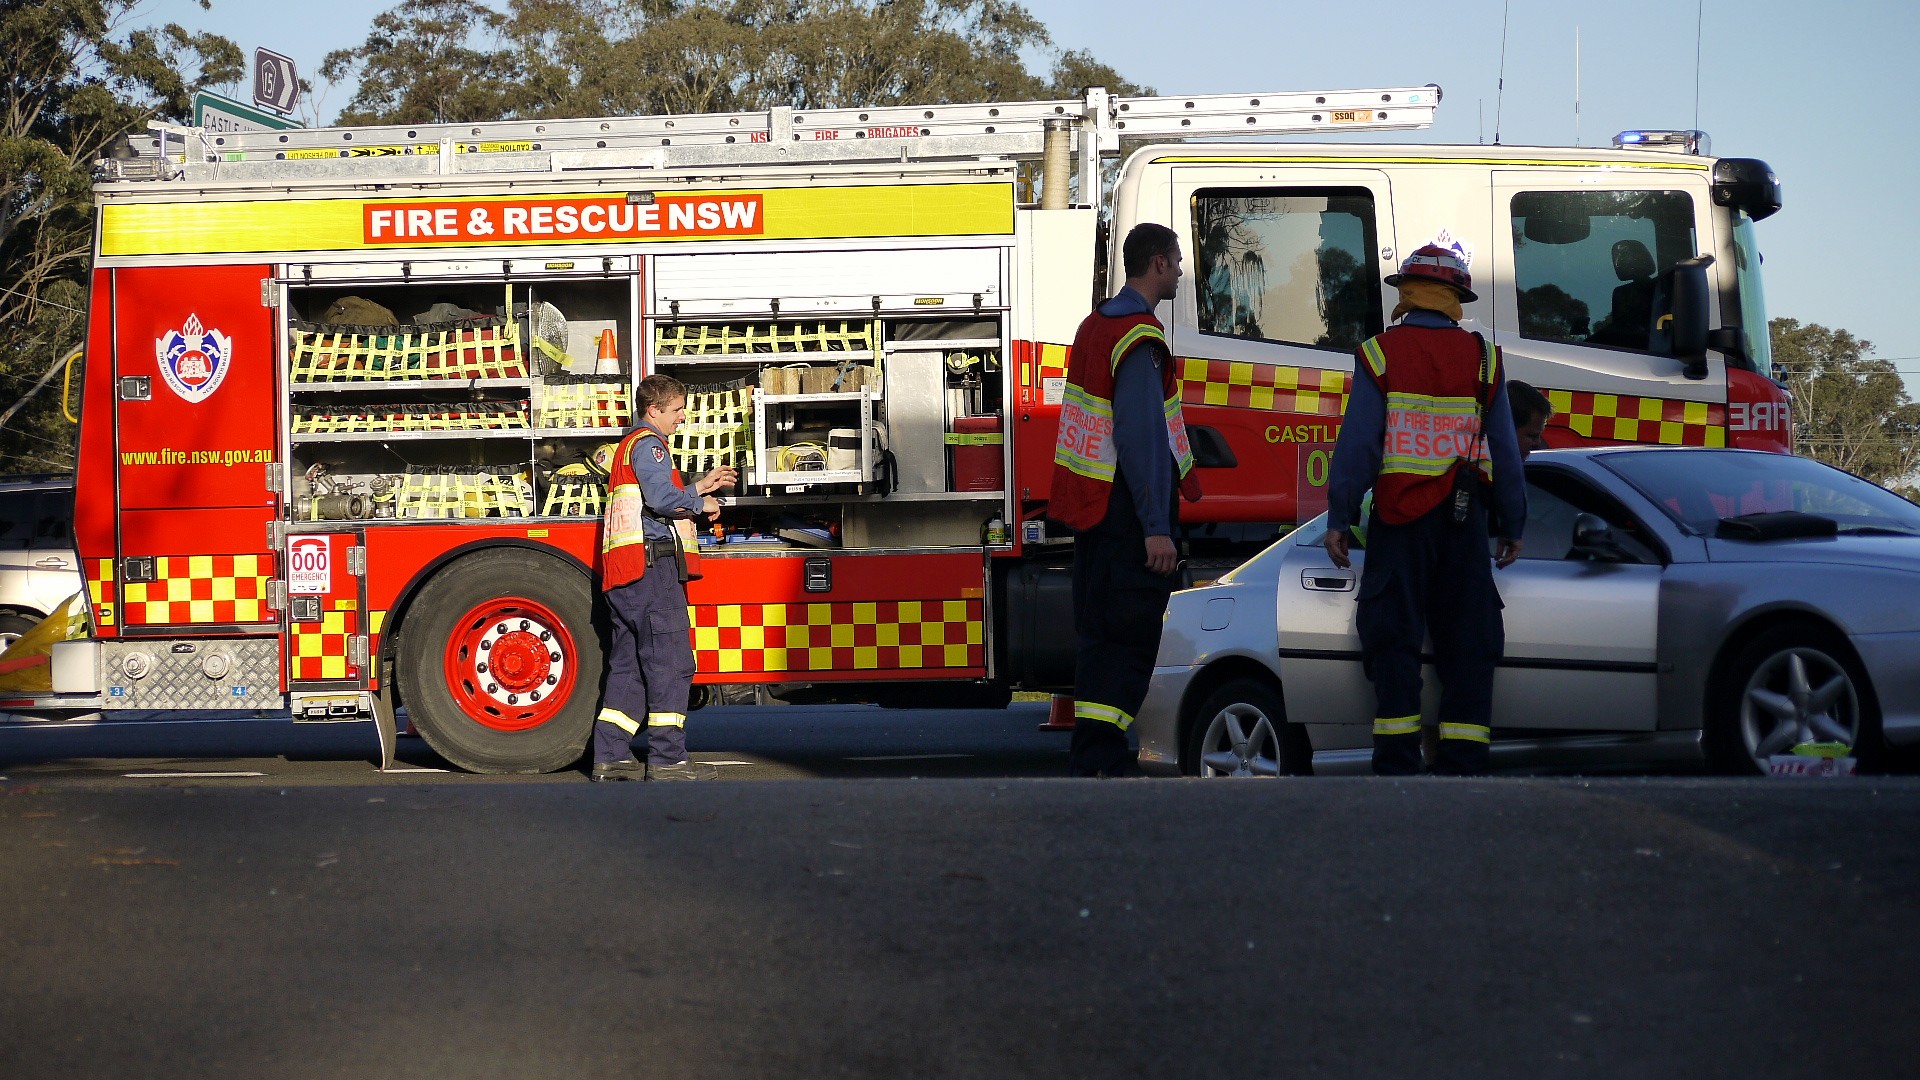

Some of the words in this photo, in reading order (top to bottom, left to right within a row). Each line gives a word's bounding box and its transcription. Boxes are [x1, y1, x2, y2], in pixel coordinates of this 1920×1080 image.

[264, 71, 273, 94] 15
[815, 130, 839, 141] FIRE
[867, 126, 919, 138] BRIGADES
[370, 208, 459, 238] FIRE
[466, 207, 495, 235] &
[504, 203, 661, 235] RESCUE
[668, 201, 758, 230] NSW
[1404, 412, 1430, 431] FIRE
[1433, 415, 1481, 434] BRIGAD
[121, 447, 272, 467] www.fire.nsw.gov.au
[291, 552, 327, 571] 000
[291, 572, 328, 581] EMERGENCY
[114, 687, 120, 696] 3
[235, 687, 242, 695] 4
